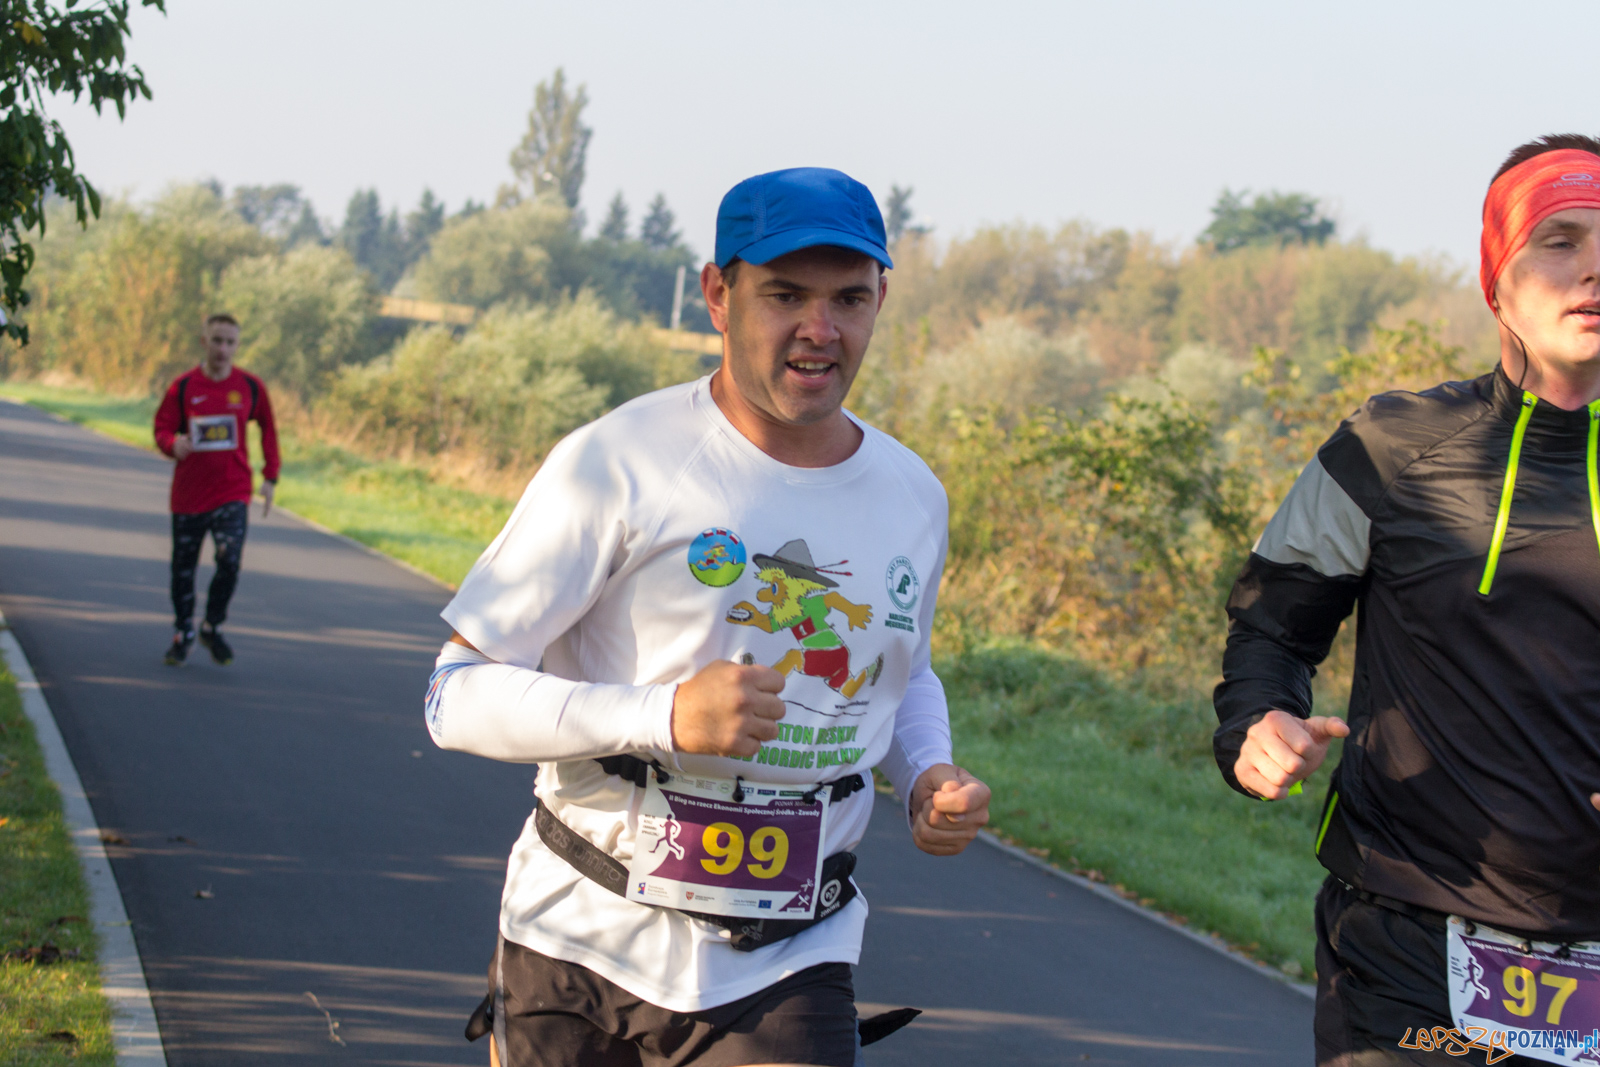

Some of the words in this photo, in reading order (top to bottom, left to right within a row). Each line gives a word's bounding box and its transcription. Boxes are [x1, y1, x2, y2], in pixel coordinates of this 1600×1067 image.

[775, 722, 814, 745] ATON
[757, 746, 815, 770] NORDIC
[674, 796, 688, 805] Bieg
[697, 801, 713, 809] rzecz
[713, 803, 743, 813] Ekonomii
[798, 809, 820, 818] Zawady
[700, 821, 790, 879] 99
[1502, 965, 1578, 1025] 97
